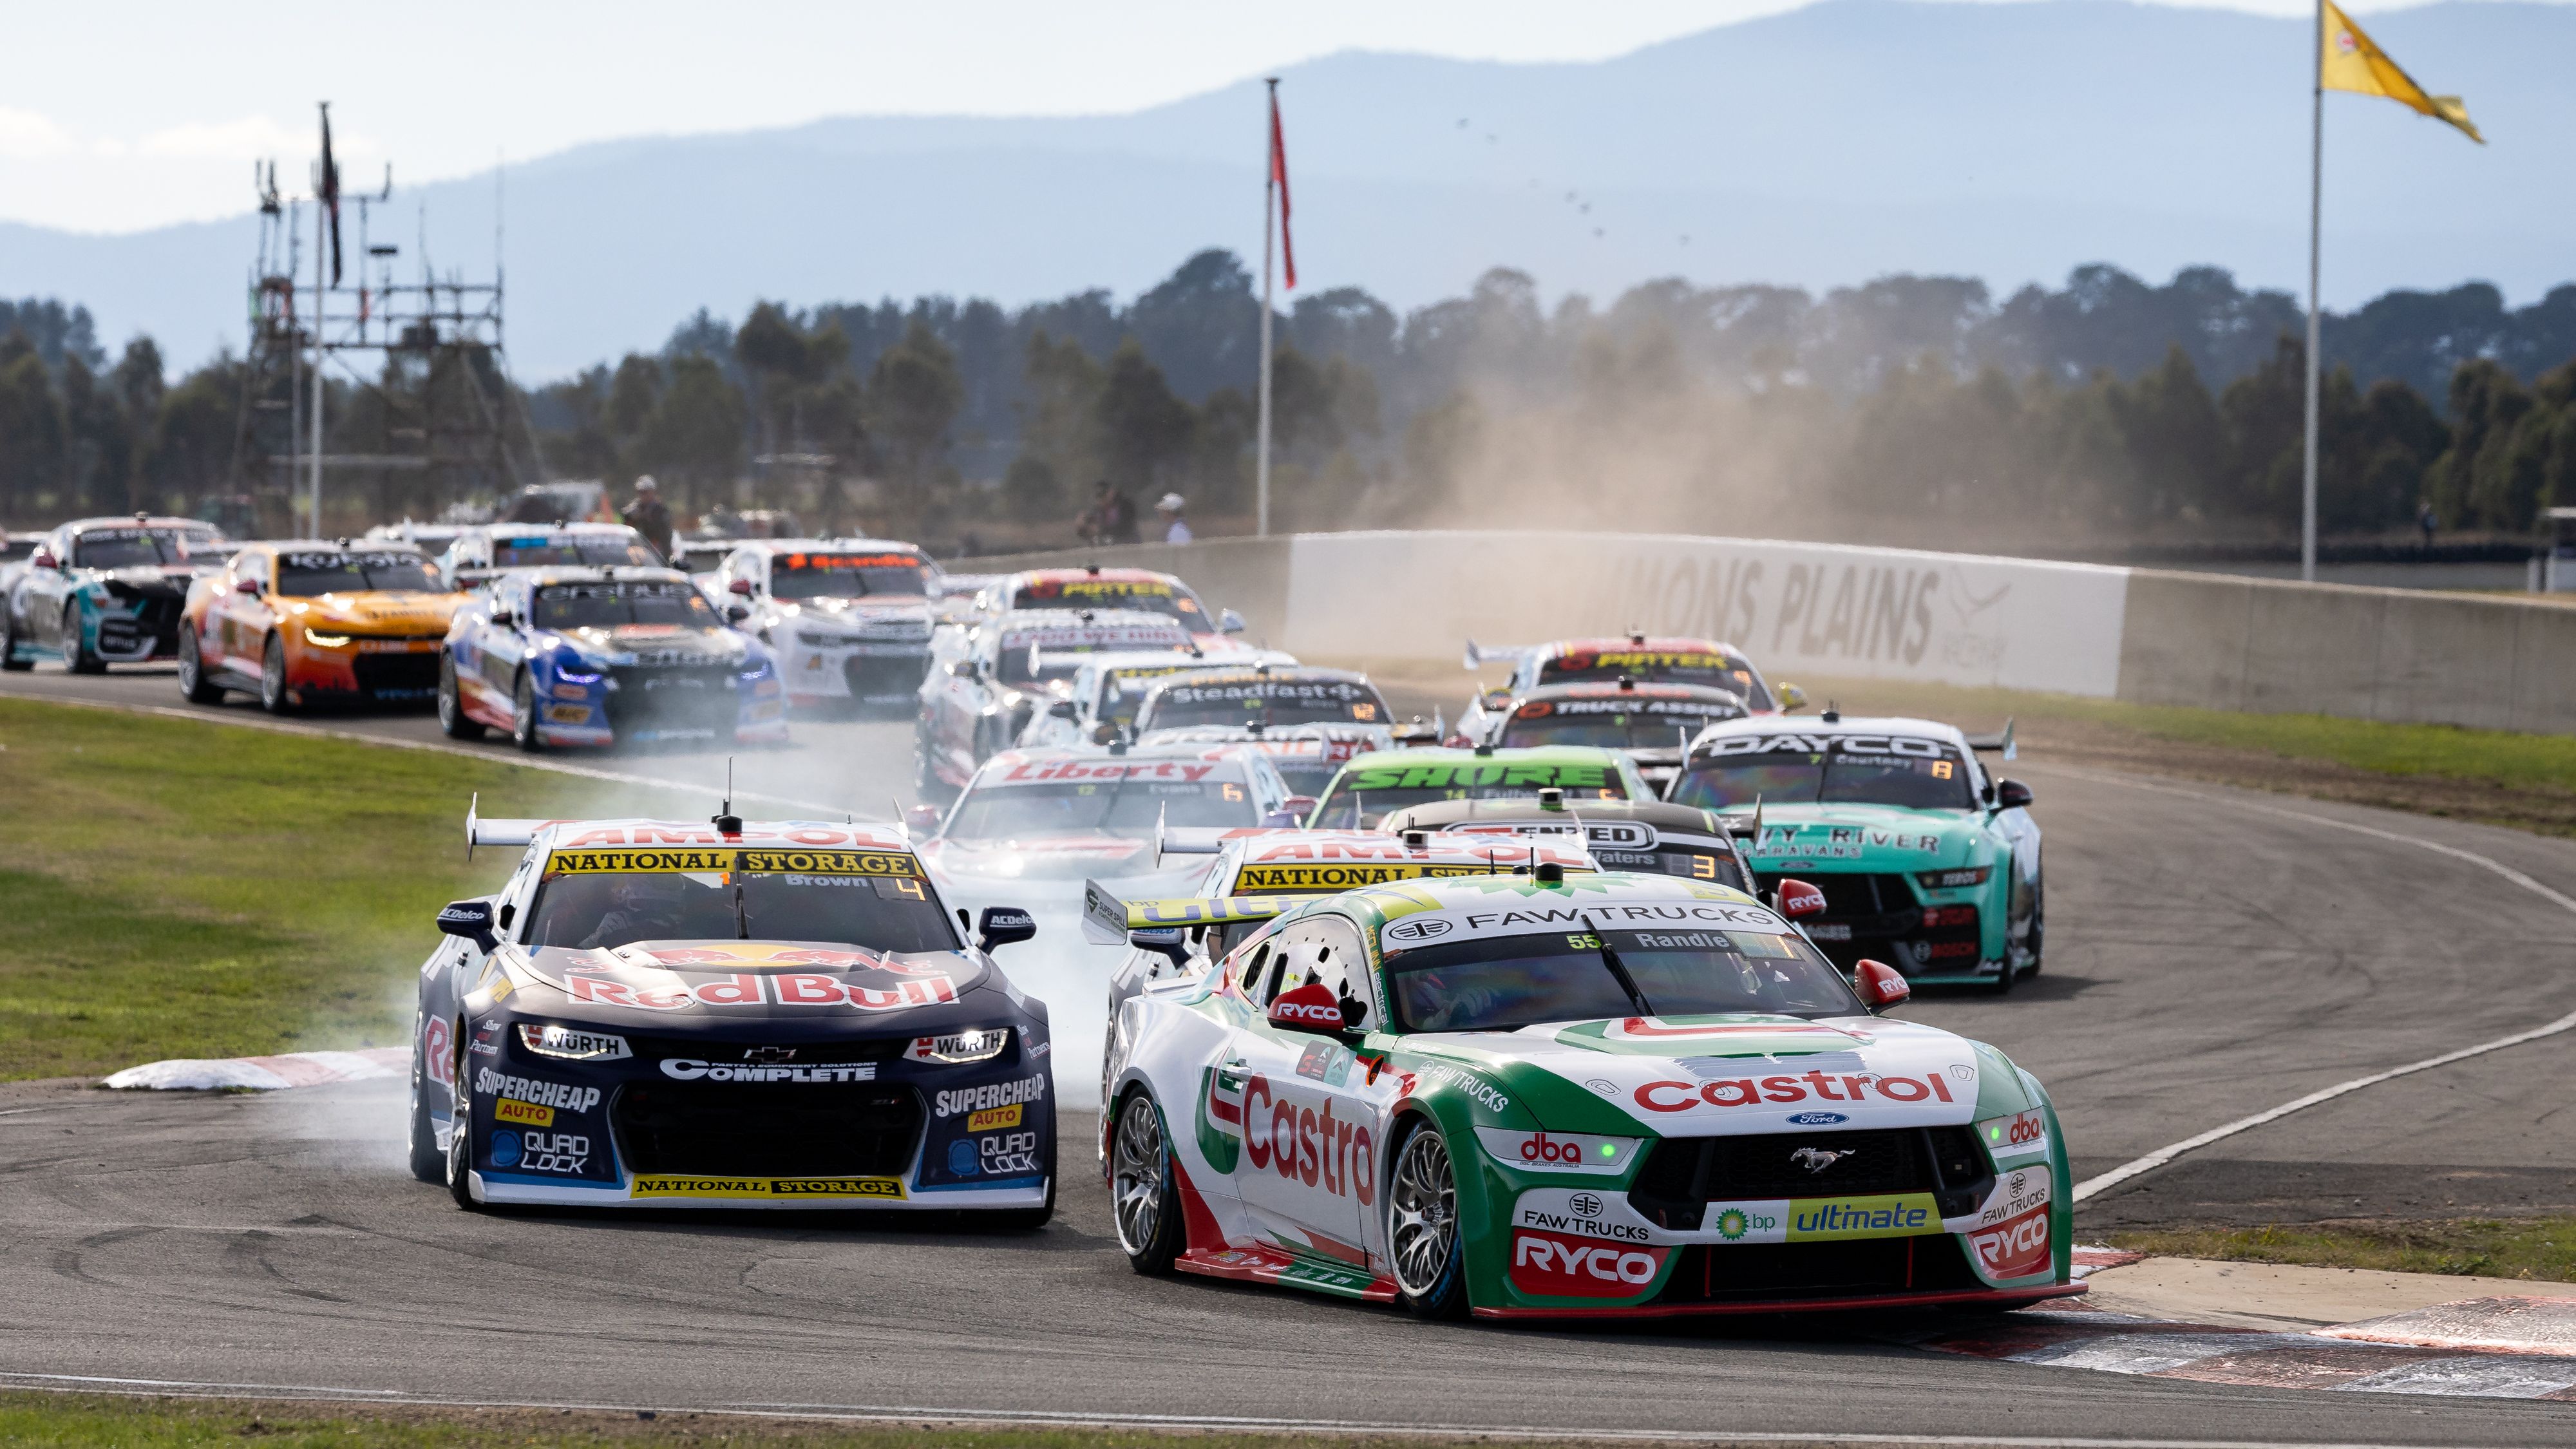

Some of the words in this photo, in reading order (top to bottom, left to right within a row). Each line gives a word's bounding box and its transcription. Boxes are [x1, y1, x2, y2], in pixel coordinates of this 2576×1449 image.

[1771, 562, 1941, 666] PLAINS
[1173, 683, 1326, 703] Steadfast
[1556, 701, 1643, 714] TRUCK
[1710, 735, 1942, 759] DAYCO
[1003, 762, 1214, 782] Liberty
[1349, 768, 1607, 790] SHURE
[1223, 782, 1244, 802] 6
[566, 829, 902, 849] AMPOL
[1518, 827, 1635, 842] ENED
[1831, 828, 1940, 855] RIVER
[555, 853, 727, 870] NATIONAL
[746, 853, 911, 874] STORAGE
[1256, 844, 1584, 866] AMPOL
[1244, 868, 1411, 886] NATIONAL
[1693, 855, 1715, 878] 3
[784, 873, 869, 887] Brown
[896, 878, 926, 901] 4
[1143, 895, 1293, 922] ulti
[1788, 893, 1826, 909] RYC
[439, 907, 485, 920] ACDelco
[1099, 902, 1113, 918] SUPER
[1113, 912, 1126, 927] SPILL
[1566, 934, 1602, 950] 55
[1635, 933, 1730, 949] Randle
[564, 974, 768, 1010] Red
[772, 974, 961, 1010] Bull
[1878, 976, 1908, 994] RYC
[1374, 971, 1389, 1026] electrical
[1277, 1003, 1341, 1021] RYCO
[659, 1058, 876, 1083] COMPLETE
[475, 1066, 601, 1113] SUPERCHEAP
[935, 1072, 1045, 1118] SUPERCHEAP
[501, 1103, 548, 1121] AUTO
[972, 1110, 1016, 1127] AUTO
[1800, 1113, 1837, 1124] Ford
[2010, 1113, 2040, 1144] dba
[524, 1131, 589, 1157] QUAD
[981, 1132, 1036, 1156] QUAD
[1520, 1132, 1582, 1164] dba
[520, 1153, 588, 1175] LOCK
[981, 1151, 1037, 1175] LOCK
[636, 1180, 766, 1192] NATIONAL
[778, 1181, 895, 1193] STORAGE
[1752, 1212, 1776, 1231] bp
[1797, 1202, 1927, 1232] ultimate
[1973, 1213, 2048, 1267] RYCO
[1516, 1235, 1656, 1284] RYCO
